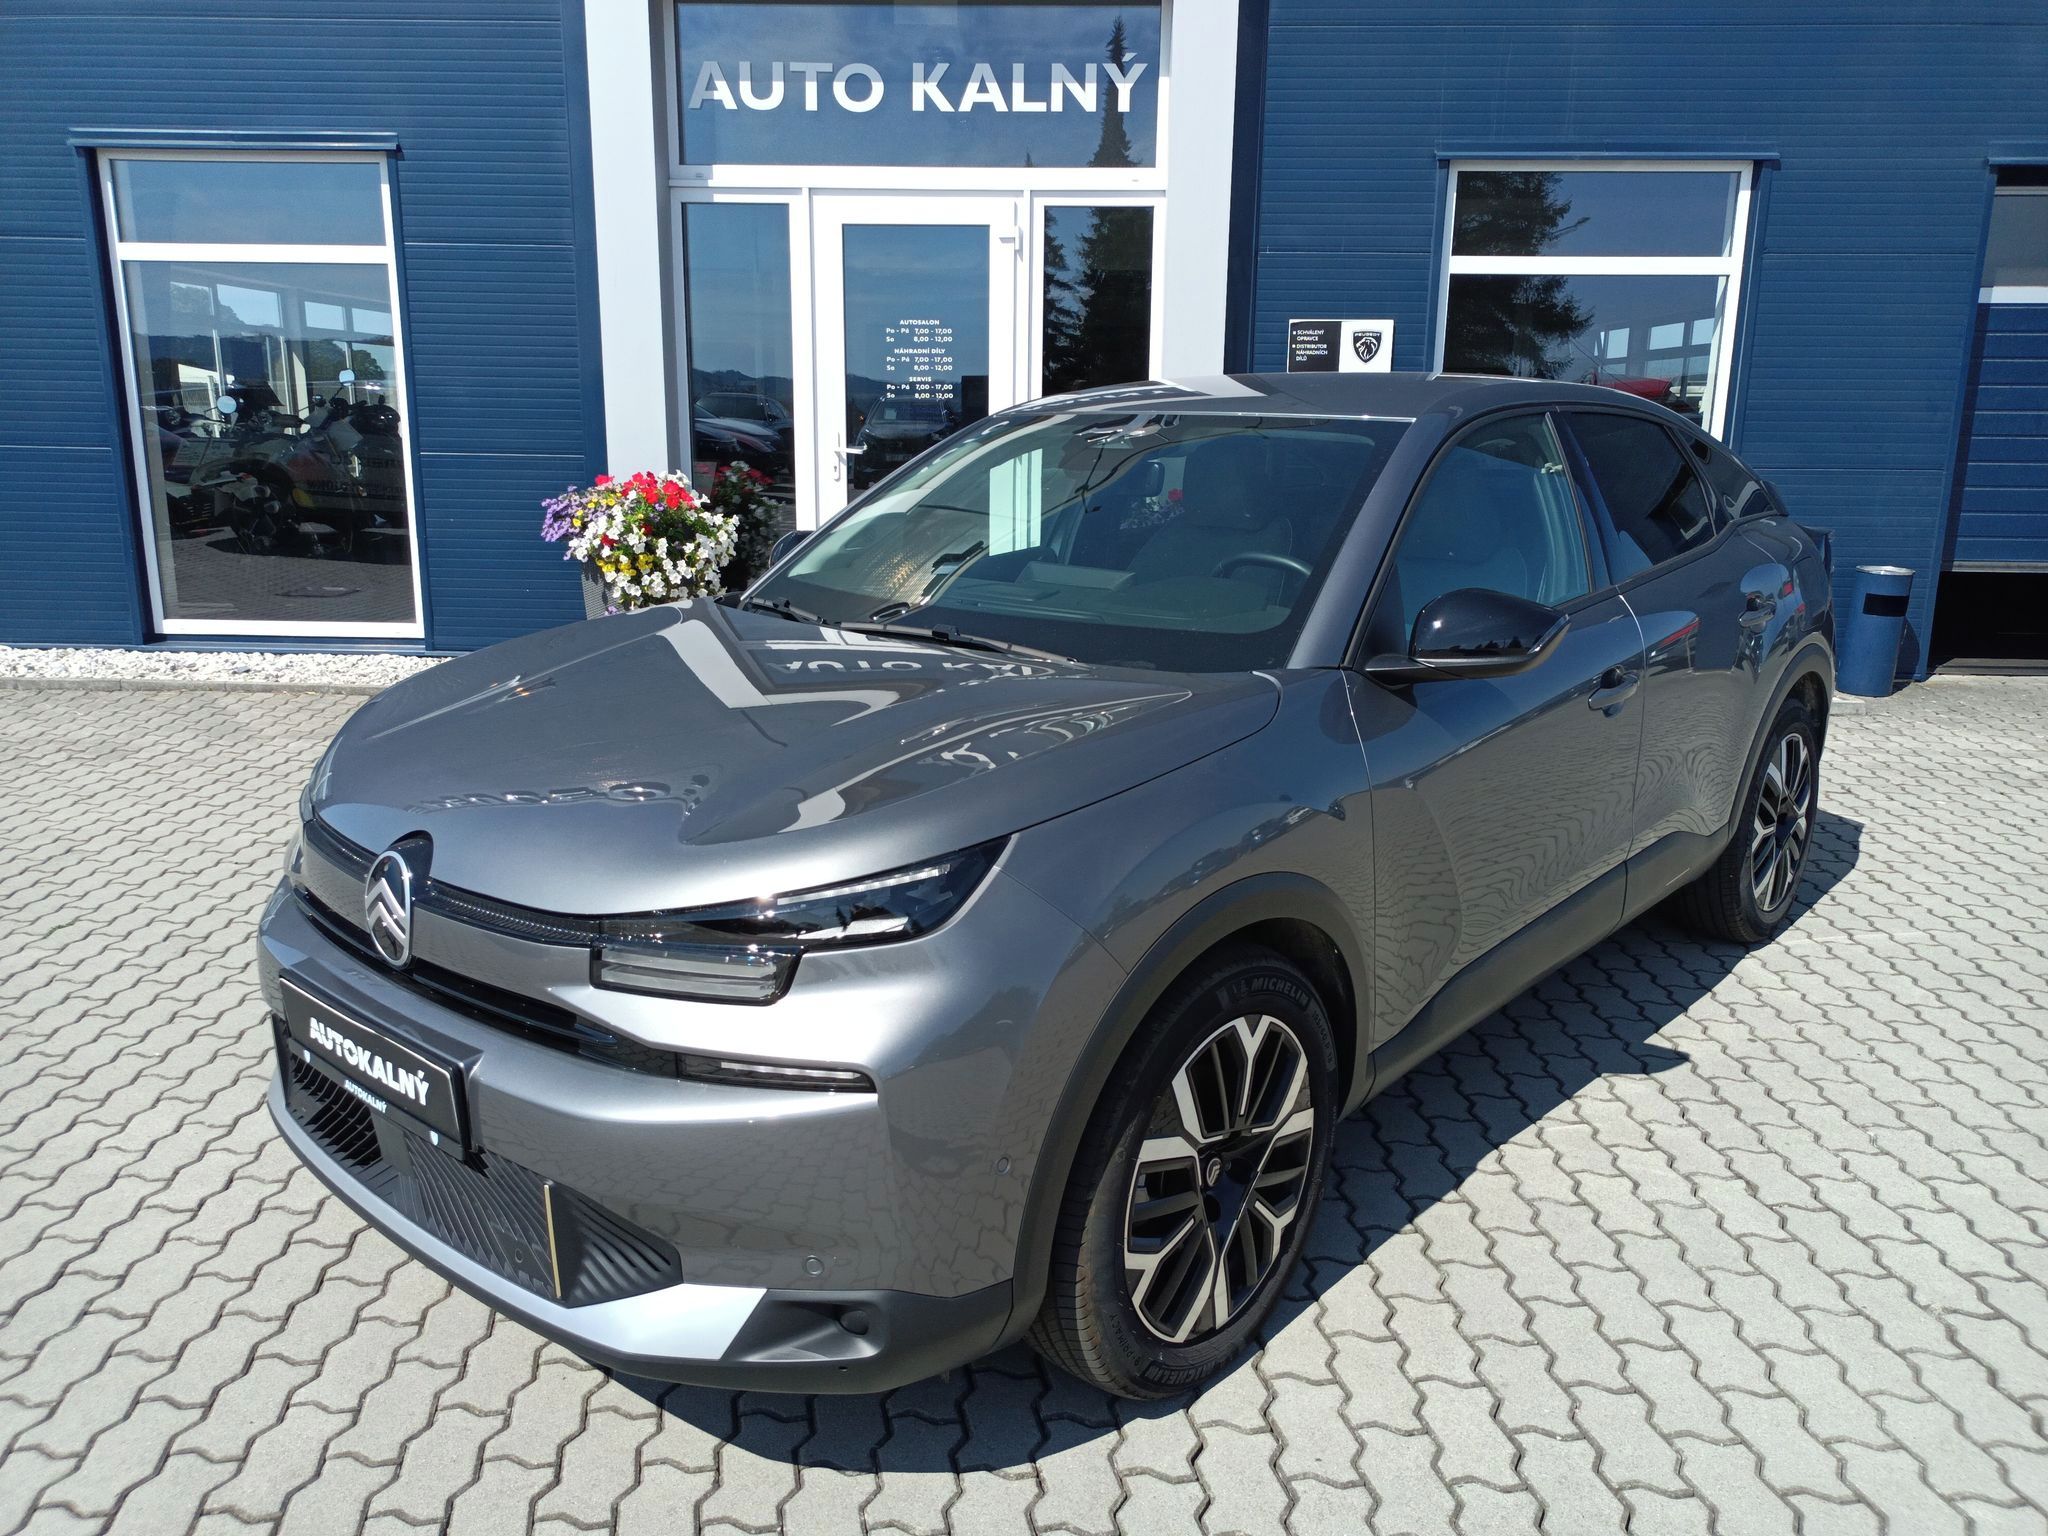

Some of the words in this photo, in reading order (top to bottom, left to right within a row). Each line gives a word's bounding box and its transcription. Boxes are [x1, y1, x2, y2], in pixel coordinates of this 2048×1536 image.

[687, 60, 886, 113] AUTO
[911, 51, 1150, 114] KALNÝ
[1251, 977, 1310, 1006] MICHELIN
[309, 1017, 430, 1106] AUTOKALNÝ
[344, 1079, 388, 1114] AUTOKALNÝ
